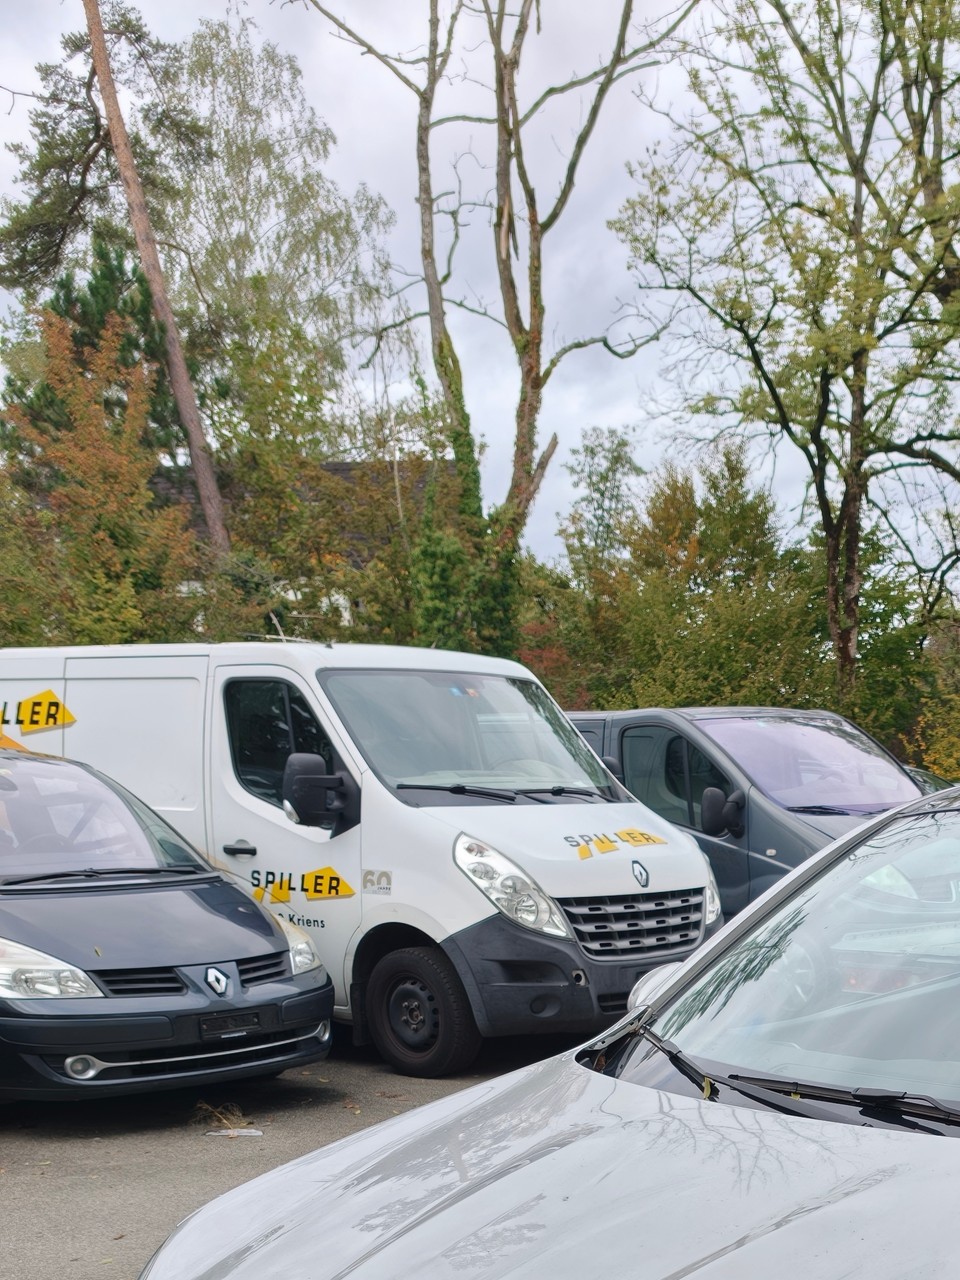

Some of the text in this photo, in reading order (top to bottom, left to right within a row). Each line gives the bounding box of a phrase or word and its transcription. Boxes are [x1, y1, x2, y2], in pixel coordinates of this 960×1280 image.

[563, 832, 657, 848] SPILLER
[251, 869, 341, 896] SPILLER
[288, 913, 326, 929] Kriens
